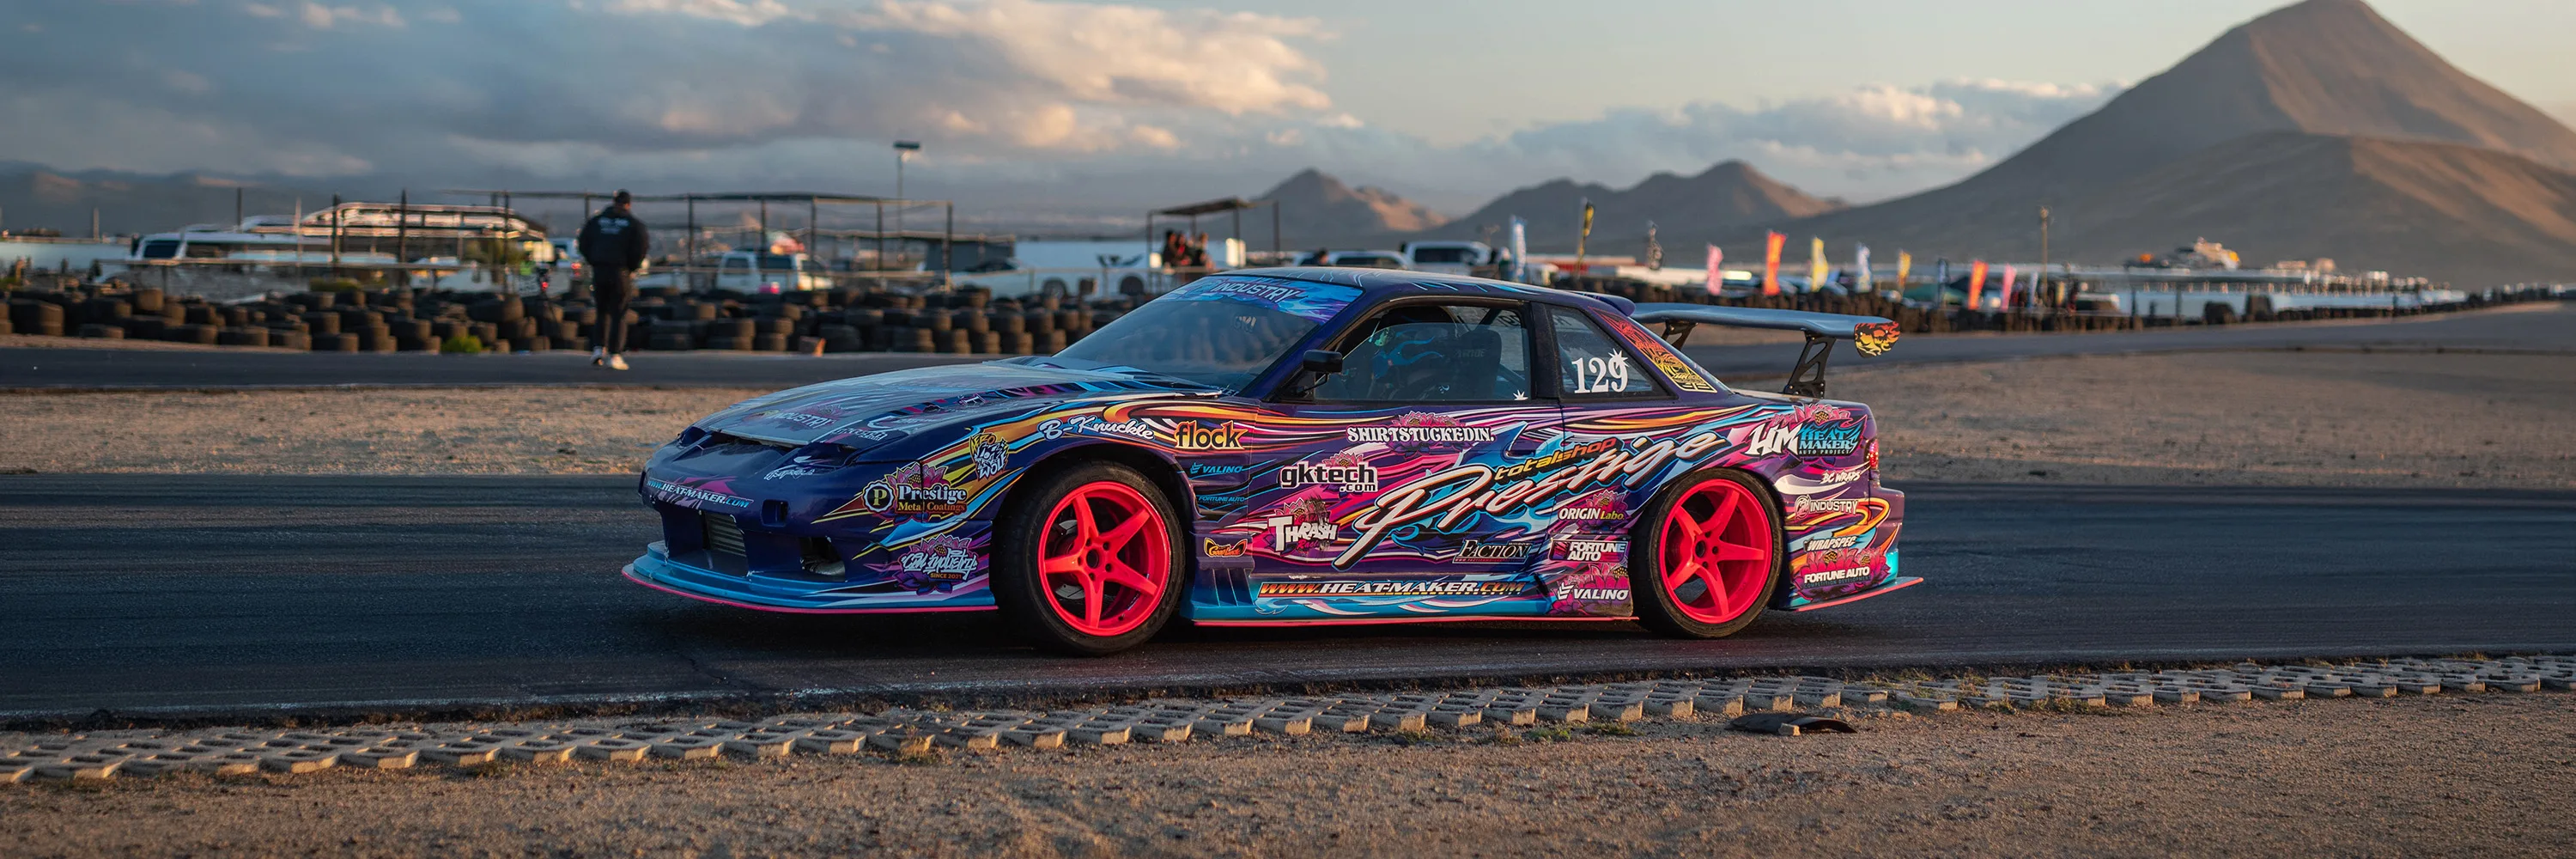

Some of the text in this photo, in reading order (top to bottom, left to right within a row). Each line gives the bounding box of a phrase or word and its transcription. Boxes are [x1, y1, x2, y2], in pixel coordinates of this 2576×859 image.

[1211, 283, 1301, 303] INDUSTRY
[1571, 348, 1629, 393] 129
[1039, 416, 1154, 440] B-Knuckle
[1175, 423, 1243, 448] flock
[1346, 427, 1495, 442] SHIRTSTUCKEDIN.
[1799, 429, 1850, 441] HEAT
[1744, 423, 1803, 456] HM
[1494, 438, 1617, 481] totalshop
[1202, 466, 1242, 474] VALINO
[1281, 464, 1375, 488] gktech
[873, 489, 888, 506] P
[898, 484, 968, 504] Prestige
[1333, 432, 1732, 570] Prestige
[927, 502, 967, 514] Coatings
[1558, 508, 1601, 520] ORIGIN
[1810, 500, 1858, 515] INDUSTRY
[1268, 516, 1339, 551] THRASH
[1569, 541, 1626, 552] FORTUNE
[1807, 536, 1857, 551] WRAPSPEC
[1567, 551, 1601, 561] AUTO
[1804, 566, 1871, 584] FORTUNE AUTO
[1260, 581, 1528, 595] WWW.HEAT-MAKER.COM
[1573, 589, 1630, 600] VALINO
